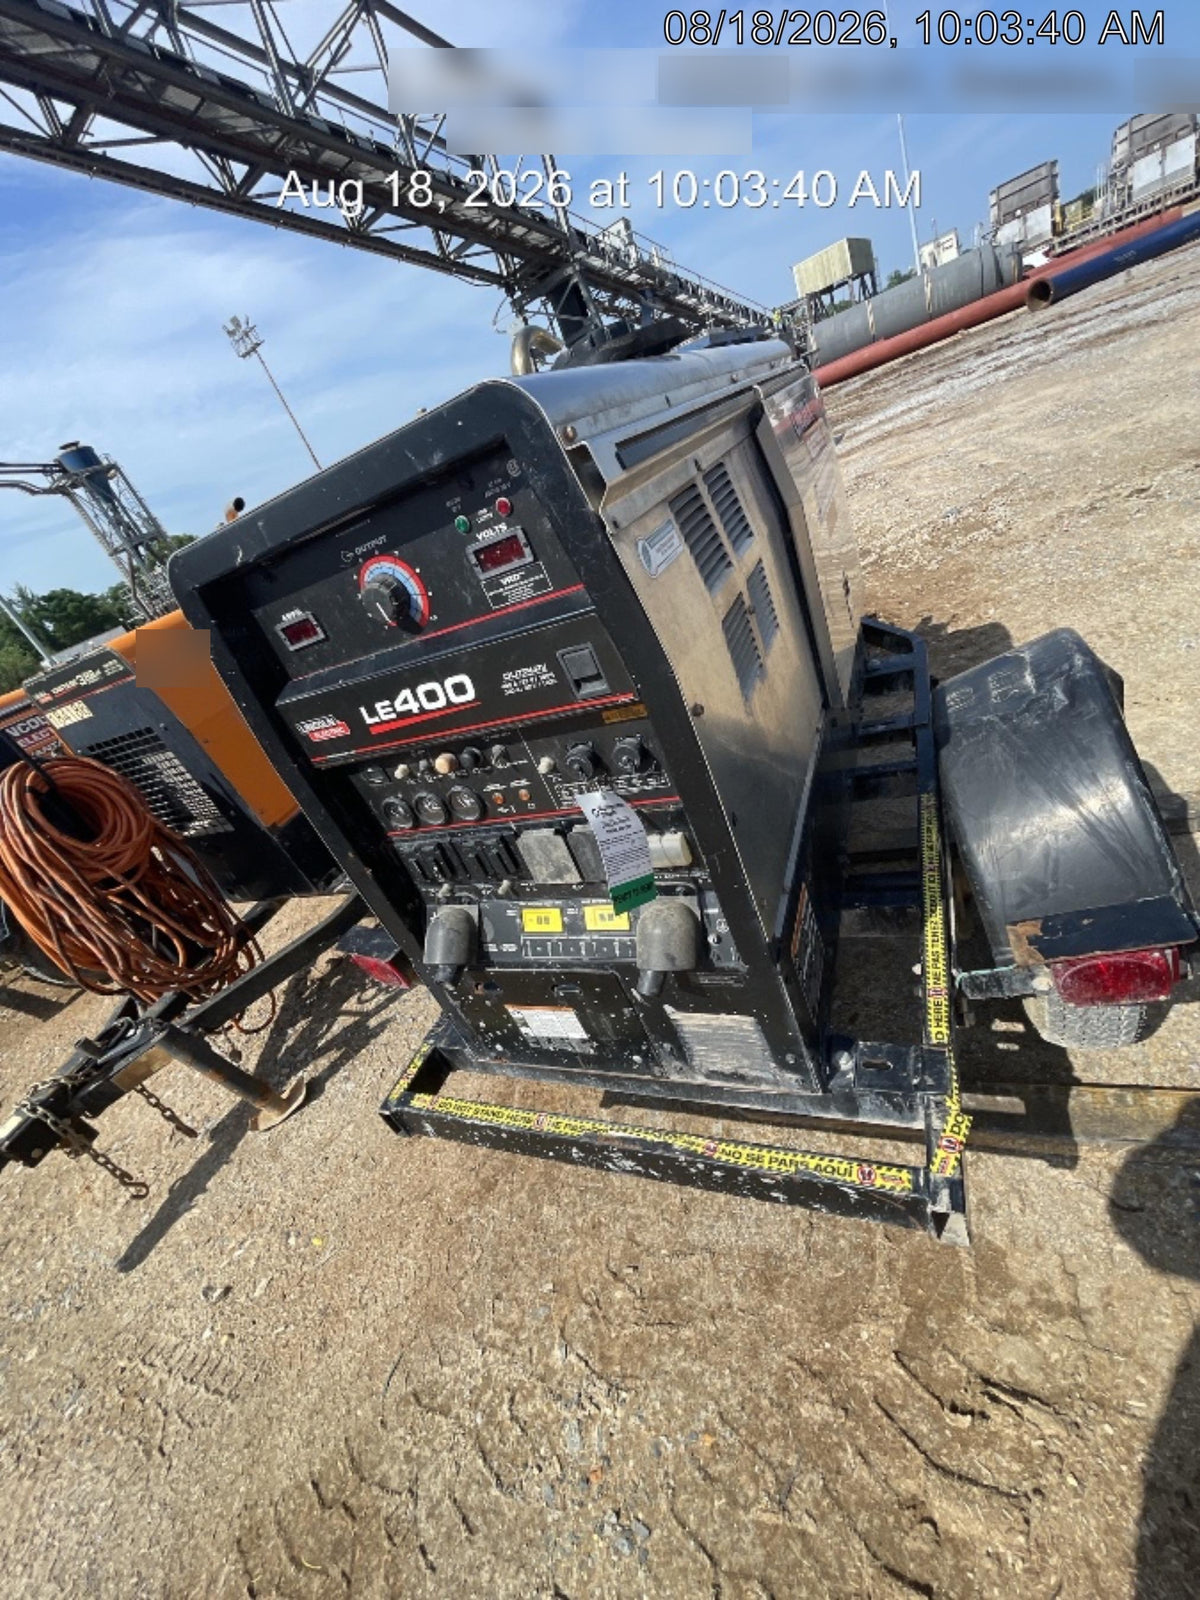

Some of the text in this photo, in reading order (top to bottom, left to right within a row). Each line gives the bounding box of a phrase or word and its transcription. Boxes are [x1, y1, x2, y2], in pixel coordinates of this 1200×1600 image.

[476, 522, 507, 541] VOLTS
[355, 534, 387, 555] OUTPUT
[359, 673, 475, 724] LE400
[932, 950, 942, 970] PAS
[934, 1000, 943, 1027] HERE
[452, 1102, 471, 1114] NOT
[473, 1105, 504, 1120] STAND
[506, 1111, 533, 1125] HERE
[950, 1113, 965, 1135] DO
[720, 1147, 743, 1161] NO
[746, 1150, 765, 1165] SE
